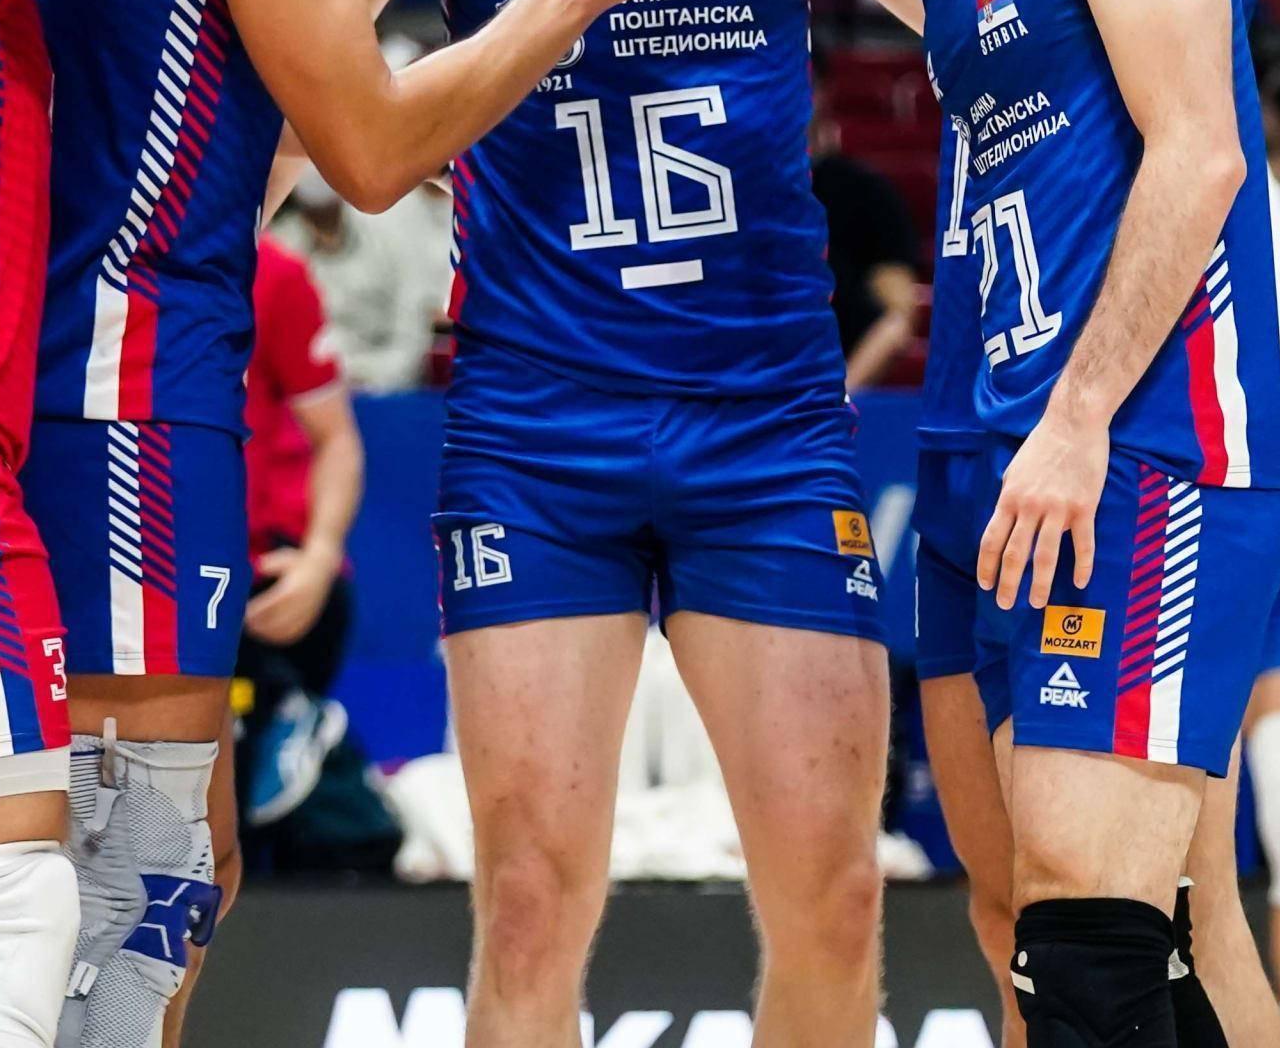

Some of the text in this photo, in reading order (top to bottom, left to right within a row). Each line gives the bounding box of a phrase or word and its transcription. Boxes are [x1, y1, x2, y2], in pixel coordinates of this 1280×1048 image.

[609, 5, 754, 31] ПОШТАНСКА
[612, 30, 768, 58] ШТЕДИОНИЦА
[980, 19, 1029, 56] SERBIA
[554, 84, 739, 251] 16
[973, 111, 1071, 176] ШТЕДИОНИЦА
[971, 189, 1063, 373] 21
[451, 522, 513, 592] 16
[199, 564, 231, 630] 7
[41, 637, 67, 701] 3
[1044, 637, 1097, 651] MOZZART
[1039, 686, 1091, 709] PEAK
